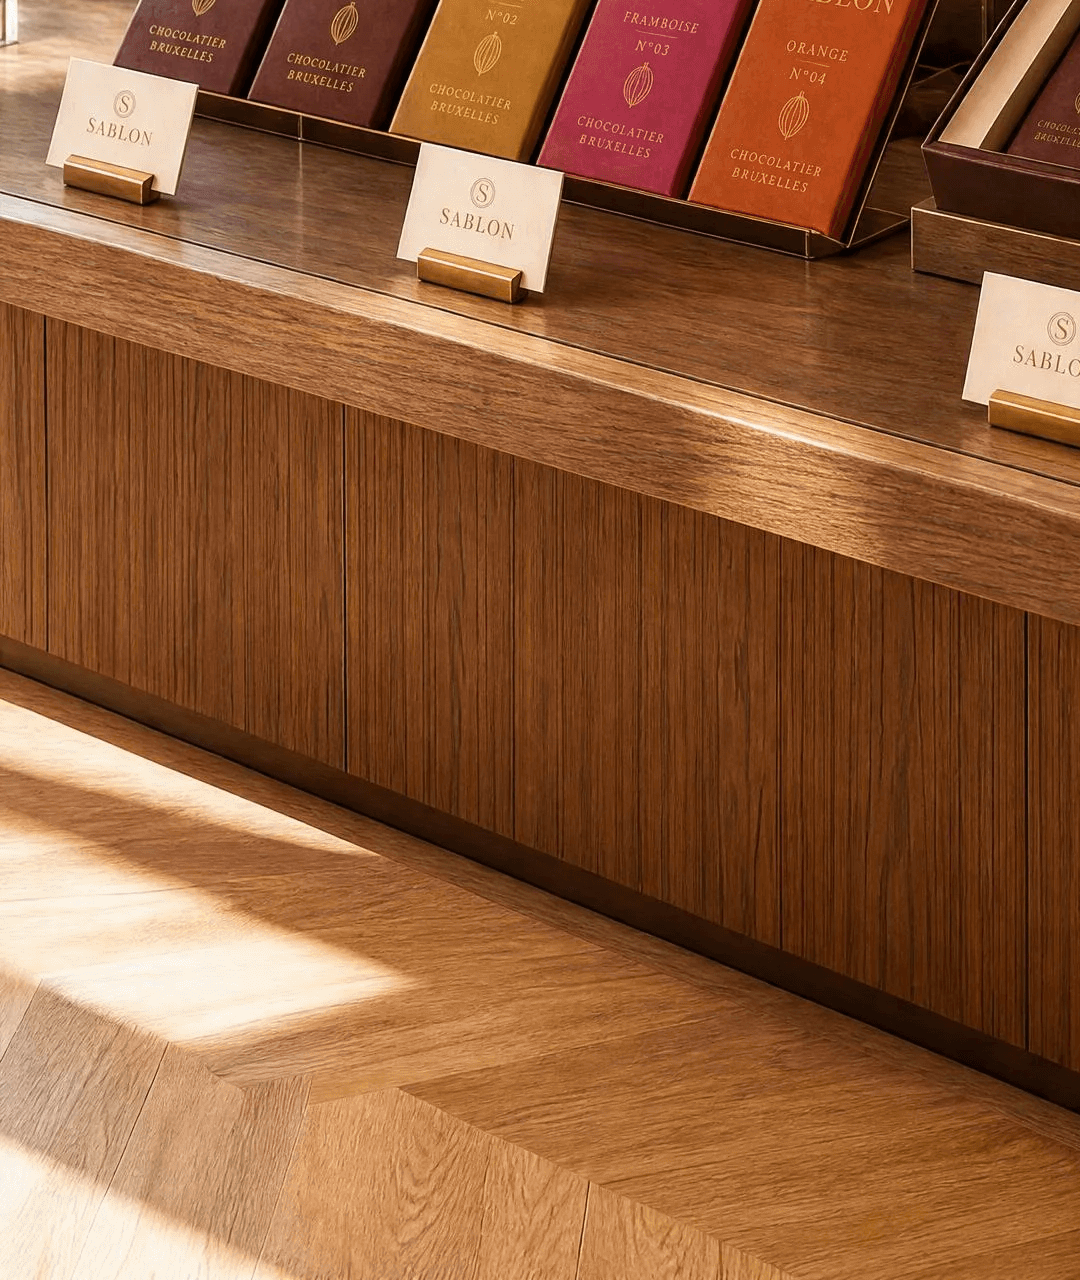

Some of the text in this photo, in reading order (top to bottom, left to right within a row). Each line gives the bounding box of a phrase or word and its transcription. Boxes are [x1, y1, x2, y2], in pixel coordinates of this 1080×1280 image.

[485, 9, 518, 25] N°02
[623, 11, 699, 34] FRAMBOISE
[150, 25, 226, 49] CHOCOLATIER
[635, 40, 670, 56] N°03
[150, 41, 214, 63] BRUXELLES
[786, 40, 848, 62] ORANGE
[287, 53, 366, 78] CHOCOLATIER
[789, 67, 826, 84] N°04
[287, 70, 353, 93] BRUXELLES
[119, 96, 129, 113] S
[430, 83, 511, 110] CHOCOLATIER
[431, 101, 500, 125] BRUXELLES
[87, 118, 152, 146] SABLON
[577, 116, 664, 144] CHOCOLATIER
[579, 134, 650, 158] BRUXELLES
[731, 149, 822, 177] CHOCOLATIER
[732, 168, 808, 193] BRUXELLES
[476, 184, 489, 202] S
[440, 208, 514, 240] SABLON
[1055, 318, 1068, 340] S
